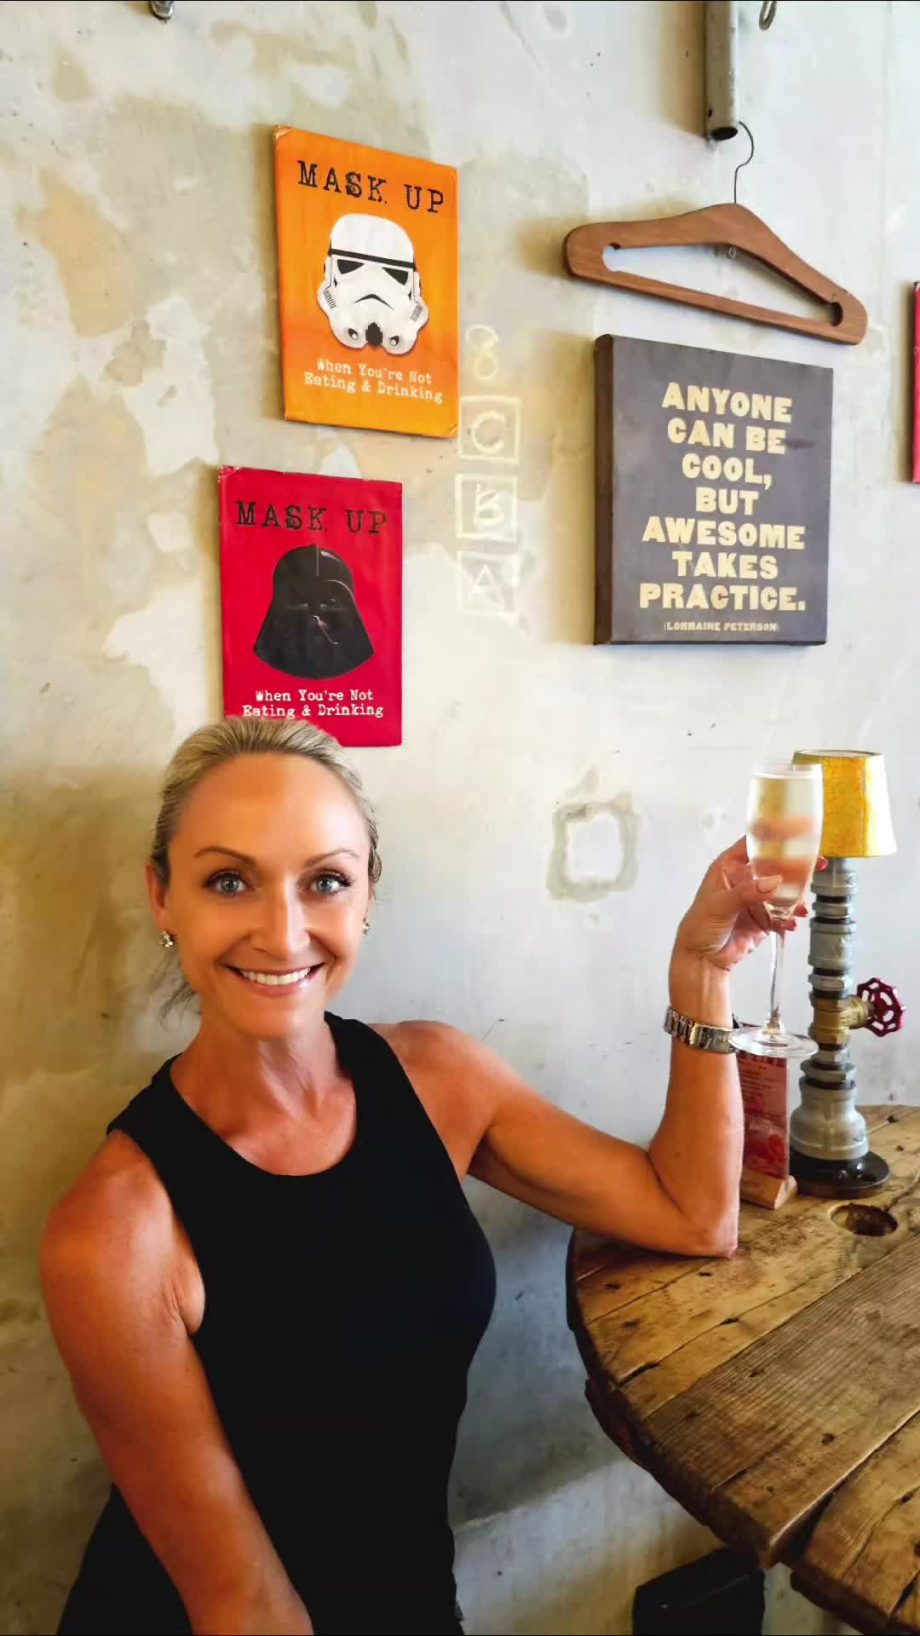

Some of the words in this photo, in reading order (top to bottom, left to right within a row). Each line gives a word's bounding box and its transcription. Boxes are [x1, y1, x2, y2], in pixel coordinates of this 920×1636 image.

[404, 184, 444, 213] UP
[316, 358, 352, 374] When
[358, 363, 403, 381] You're
[408, 371, 433, 385] Not
[304, 371, 356, 393] Eating
[361, 379, 372, 393] &
[377, 380, 443, 404] Drinking
[662, 382, 792, 423] ANYONE
[667, 417, 734, 449] CAN
[745, 426, 786, 455] BE
[682, 452, 773, 490] COOL,
[695, 486, 760, 516] BUT
[346, 508, 387, 533] UP
[642, 516, 806, 550] AWESOME
[672, 551, 779, 580] TAKES
[639, 583, 806, 612] PRACTICE.
[255, 689, 292, 702] When
[298, 689, 344, 702] You're
[349, 689, 374, 701] Not
[242, 704, 296, 719] Eating
[301, 704, 312, 717] &
[318, 703, 384, 718] Drinking
